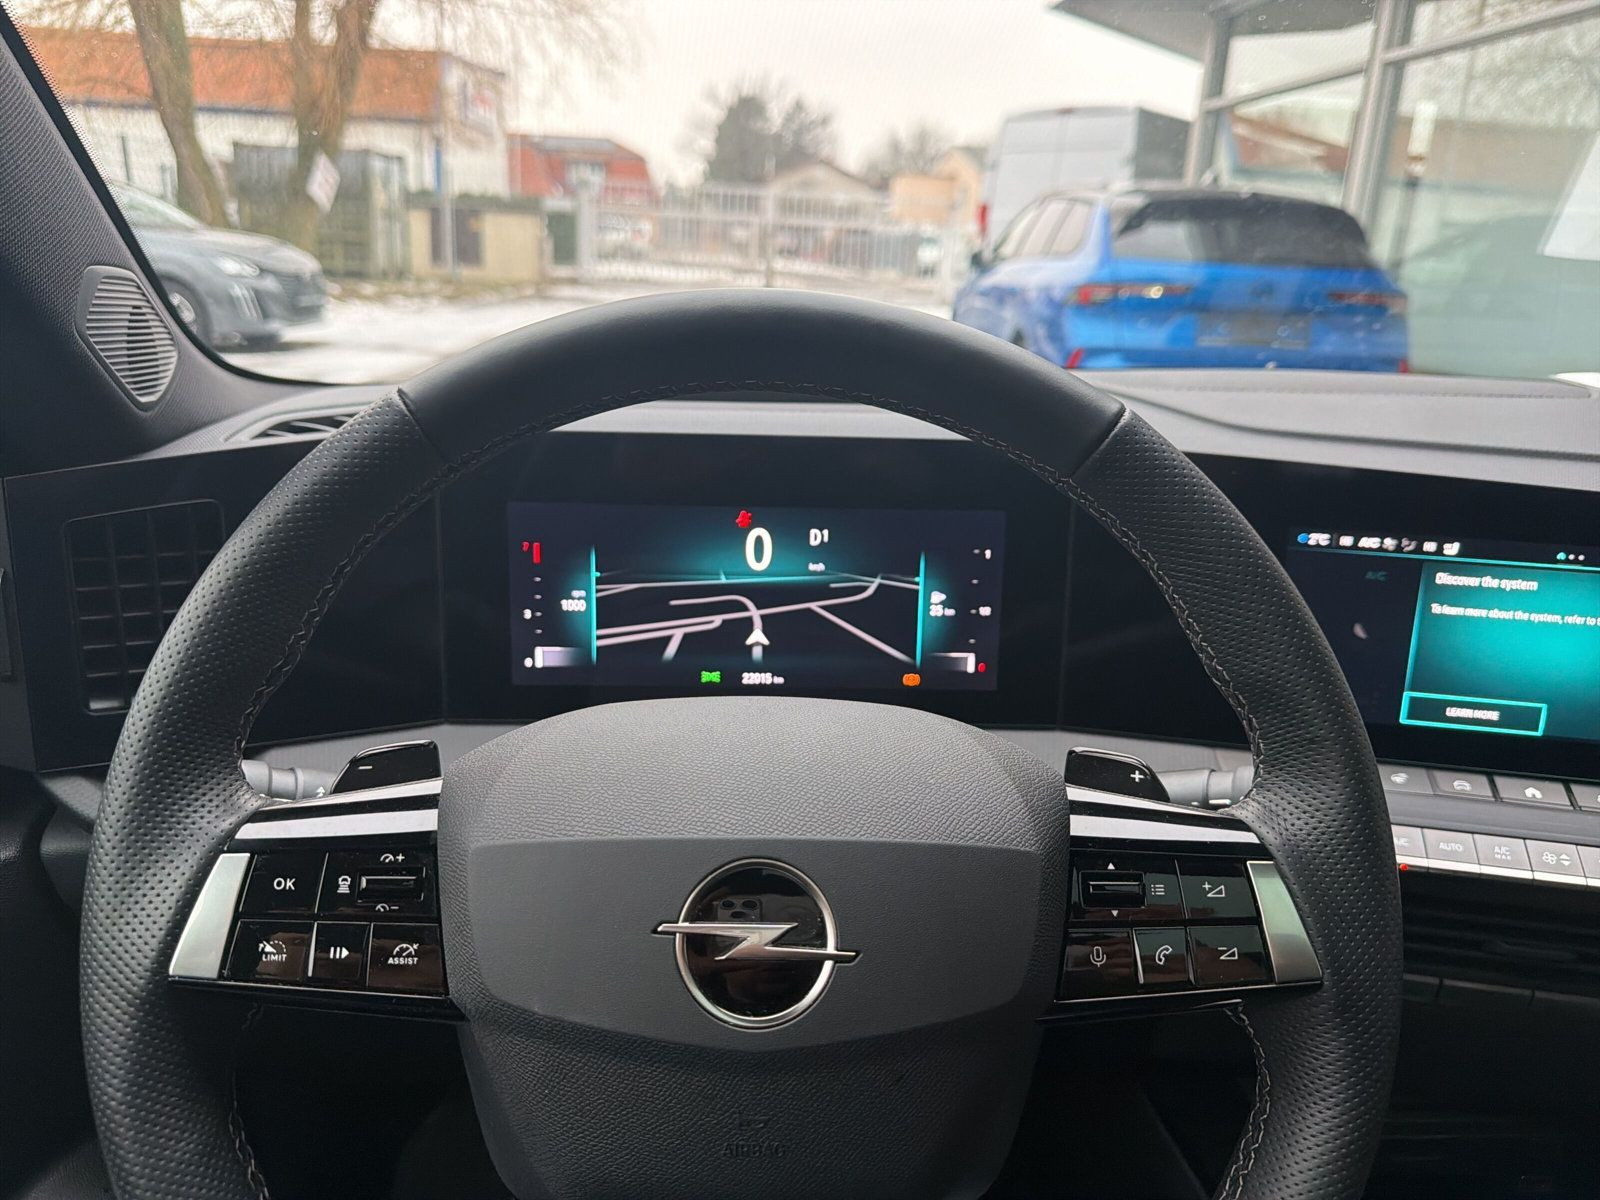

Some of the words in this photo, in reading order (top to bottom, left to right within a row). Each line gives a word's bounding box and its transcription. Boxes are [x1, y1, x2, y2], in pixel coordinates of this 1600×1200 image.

[745, 527, 773, 572] 0
[1435, 572, 1481, 587] Discover
[1481, 576, 1499, 588] the
[1500, 579, 1538, 591] system
[1431, 603, 1442, 614] To
[1464, 607, 1488, 618] more
[1488, 609, 1513, 620] about
[1514, 610, 1529, 621] the
[1564, 614, 1586, 625] refer
[1586, 616, 1596, 626] to
[1445, 706, 1473, 719] LEARN
[1474, 709, 1500, 721] MORE
[1438, 842, 1463, 852] AUTO
[1494, 846, 1511, 855] A/C
[273, 877, 296, 891] OK
[262, 954, 287, 962] LIMIT
[387, 957, 418, 965] ASSIST
